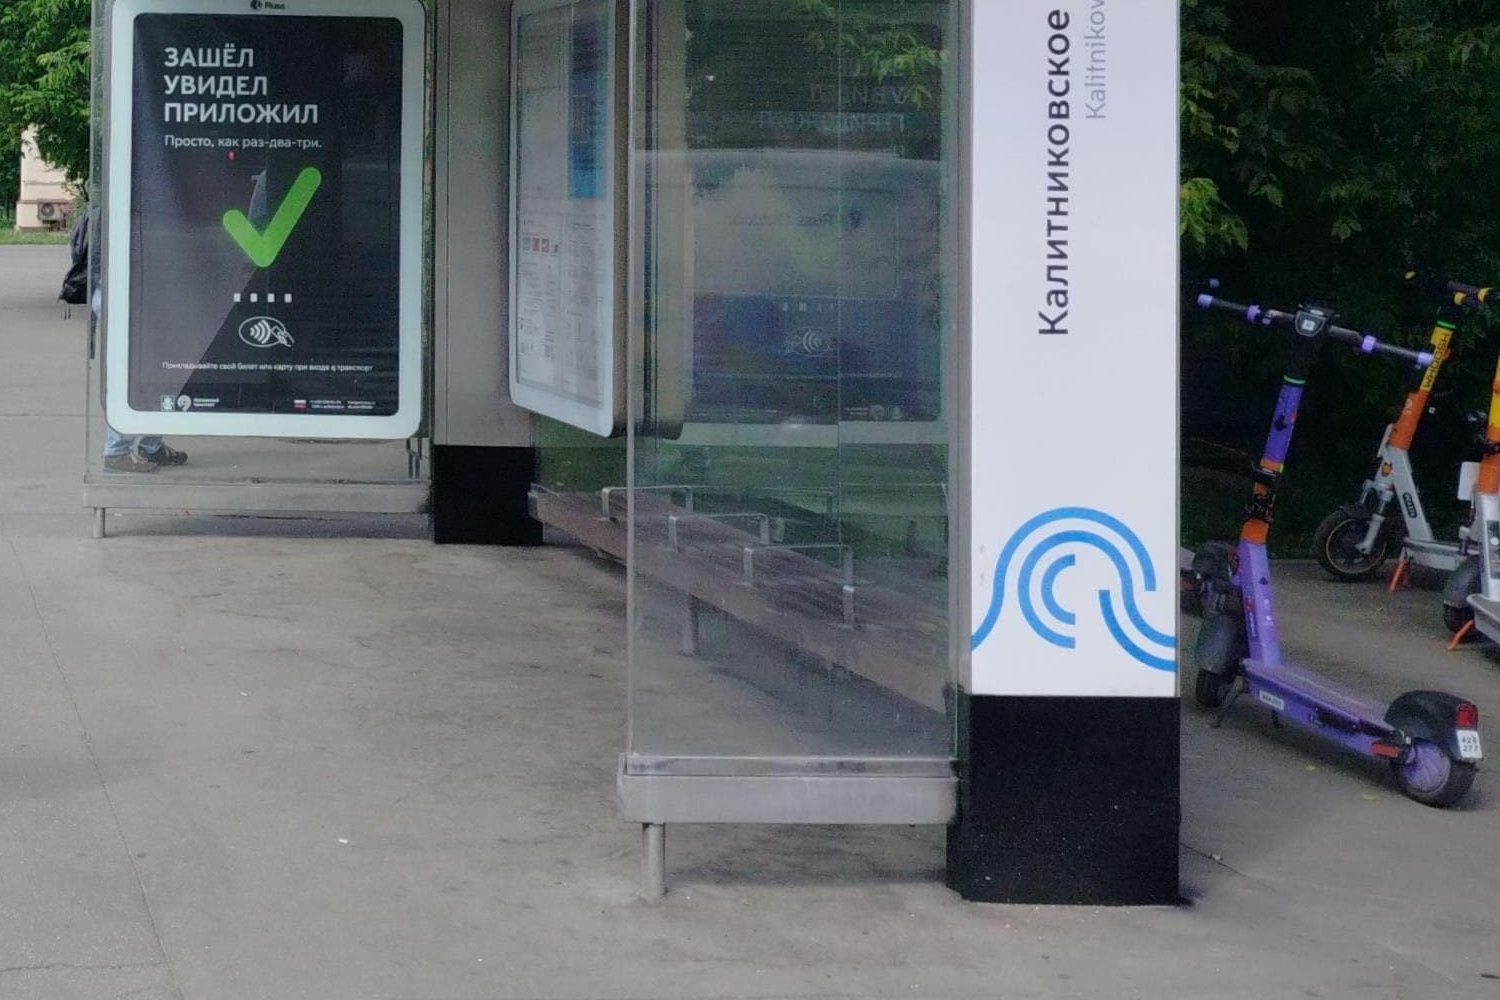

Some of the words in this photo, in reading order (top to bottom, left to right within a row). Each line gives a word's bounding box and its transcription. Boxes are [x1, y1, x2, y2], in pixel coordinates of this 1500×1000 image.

[164, 43, 254, 68] ЗАШЁЛ
[164, 75, 268, 99] УВИДЕЛ
[164, 103, 319, 124] ПРИЛОЖИЛ
[164, 135, 215, 148] Просто,
[218, 138, 240, 147] как
[242, 138, 323, 149] раз-два-три.
[1038, 9, 1070, 334] Калитниковское
